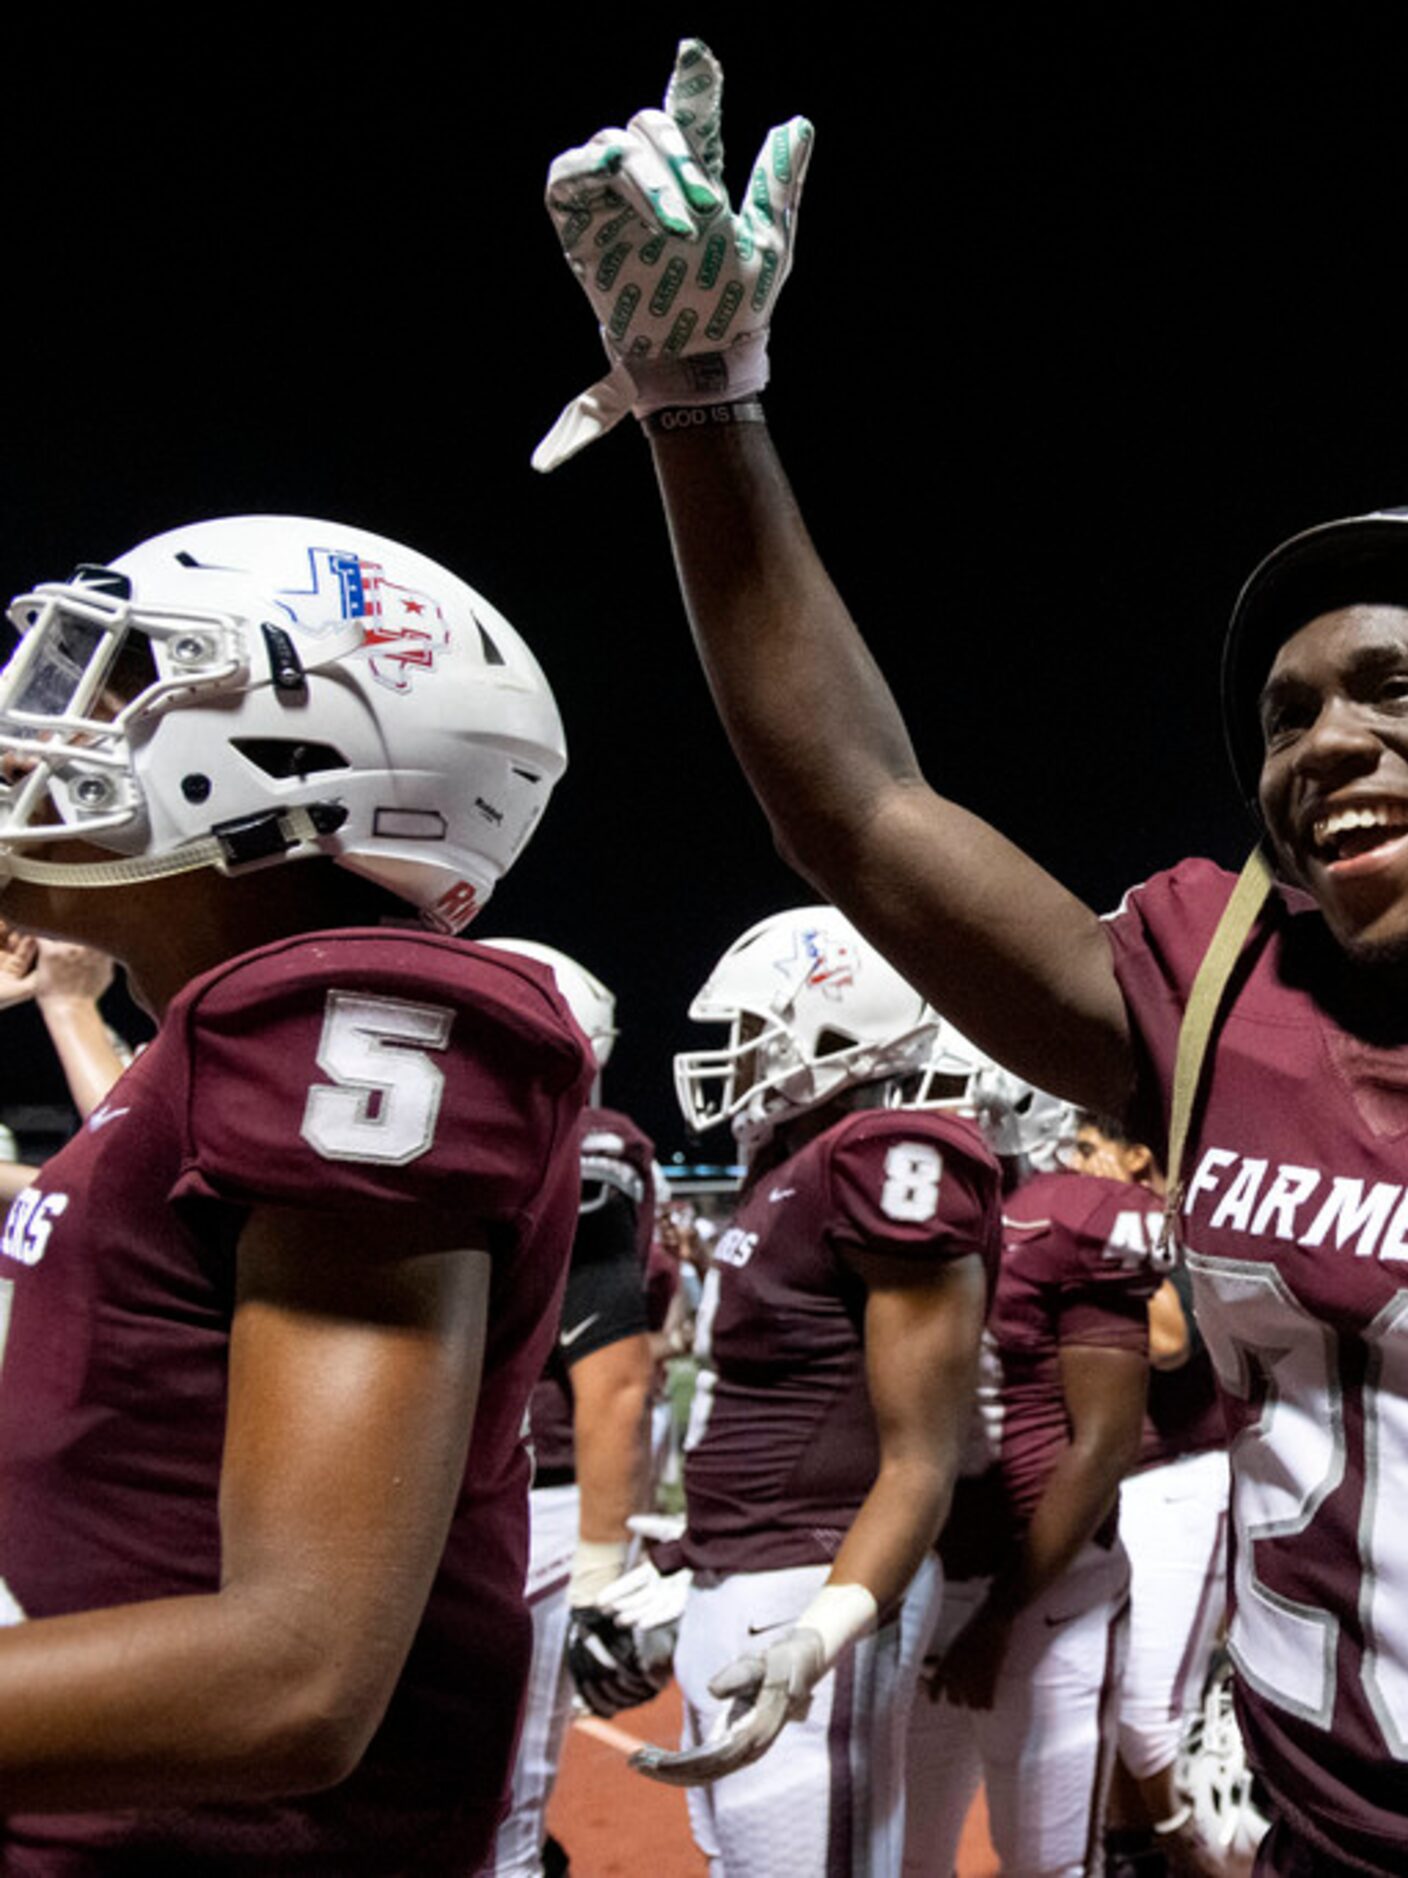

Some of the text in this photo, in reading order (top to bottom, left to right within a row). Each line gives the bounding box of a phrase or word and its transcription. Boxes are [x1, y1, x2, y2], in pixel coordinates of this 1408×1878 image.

[660, 406, 730, 430] GOD IS
[301, 988, 456, 1167] 5
[880, 1141, 944, 1223] 8
